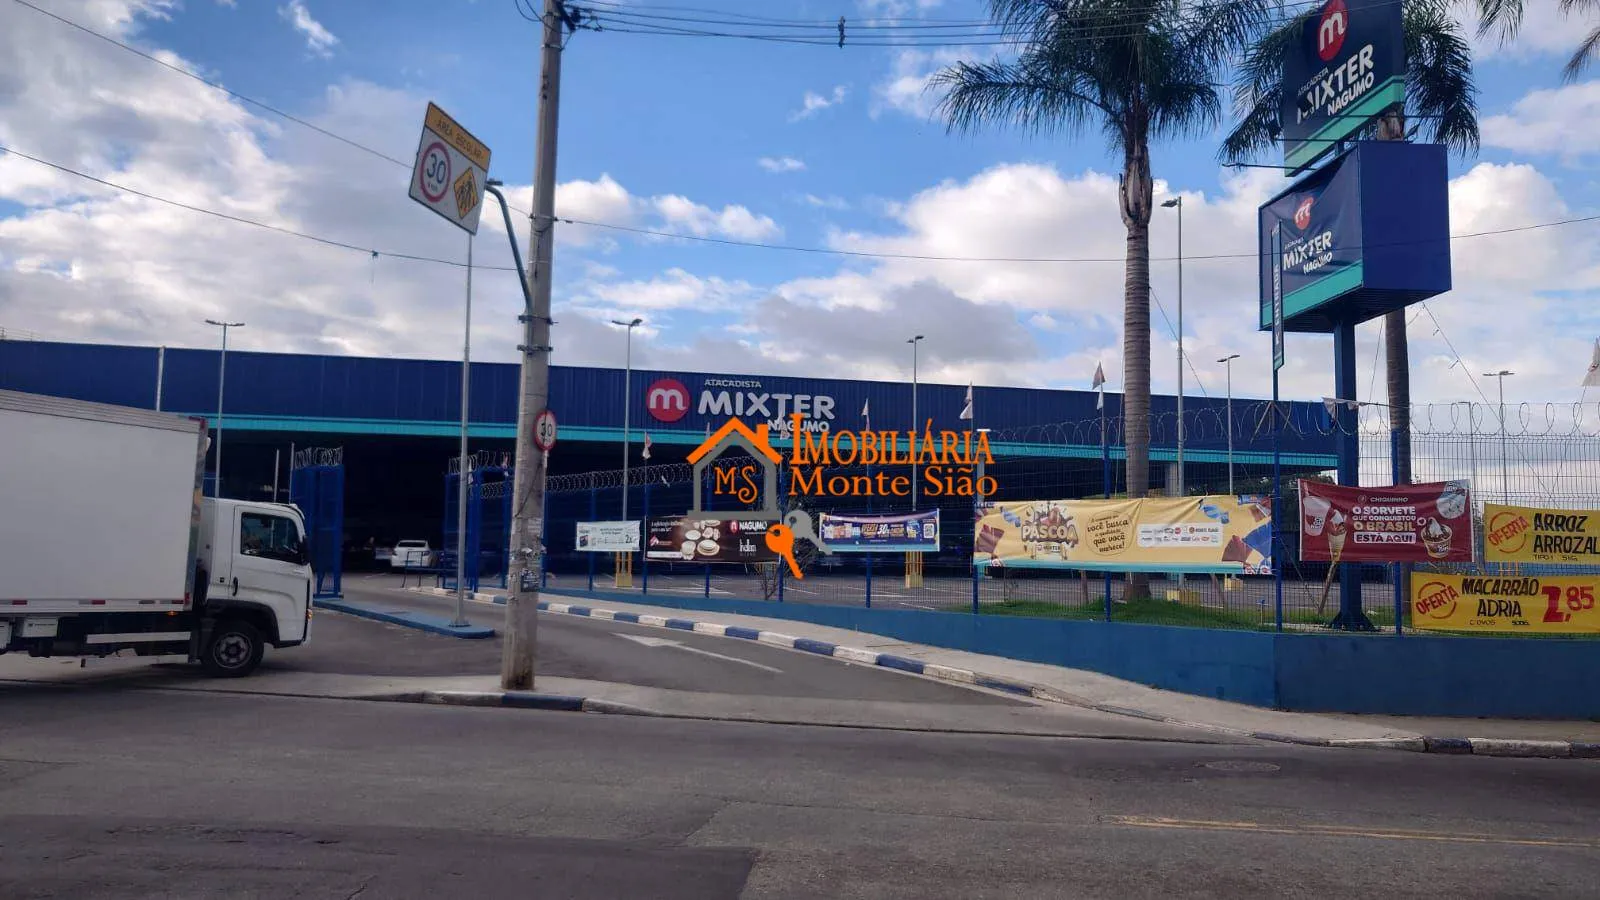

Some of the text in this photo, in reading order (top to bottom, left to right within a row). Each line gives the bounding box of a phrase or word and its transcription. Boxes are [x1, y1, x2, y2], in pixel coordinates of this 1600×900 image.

[1327, 71, 1375, 116] NAGUMO
[427, 153, 446, 184] 30
[1283, 231, 1332, 271] MIXTER
[1303, 252, 1333, 275] NAGUMO
[704, 379, 762, 388] ATACADISTA
[698, 390, 835, 420] MIXTER
[541, 423, 552, 437] 30
[768, 419, 830, 433] NAGUMO
[1352, 506, 1416, 515] O SORVETE
[739, 520, 768, 532] NAGUMO
[1087, 521, 1104, 532] você
[1106, 519, 1129, 528] busca
[1353, 521, 1416, 532] O BRASIL
[1488, 515, 1530, 546] OFERTA
[1534, 513, 1588, 532] ARROZ
[1093, 532, 1125, 547] que você
[1356, 532, 1384, 542] ESTÁ
[1534, 535, 1600, 554] ARROZAL
[1461, 578, 1539, 596] MACARRÃO
[1415, 586, 1460, 615] OFERTA
[1477, 599, 1522, 617] ADRIA
